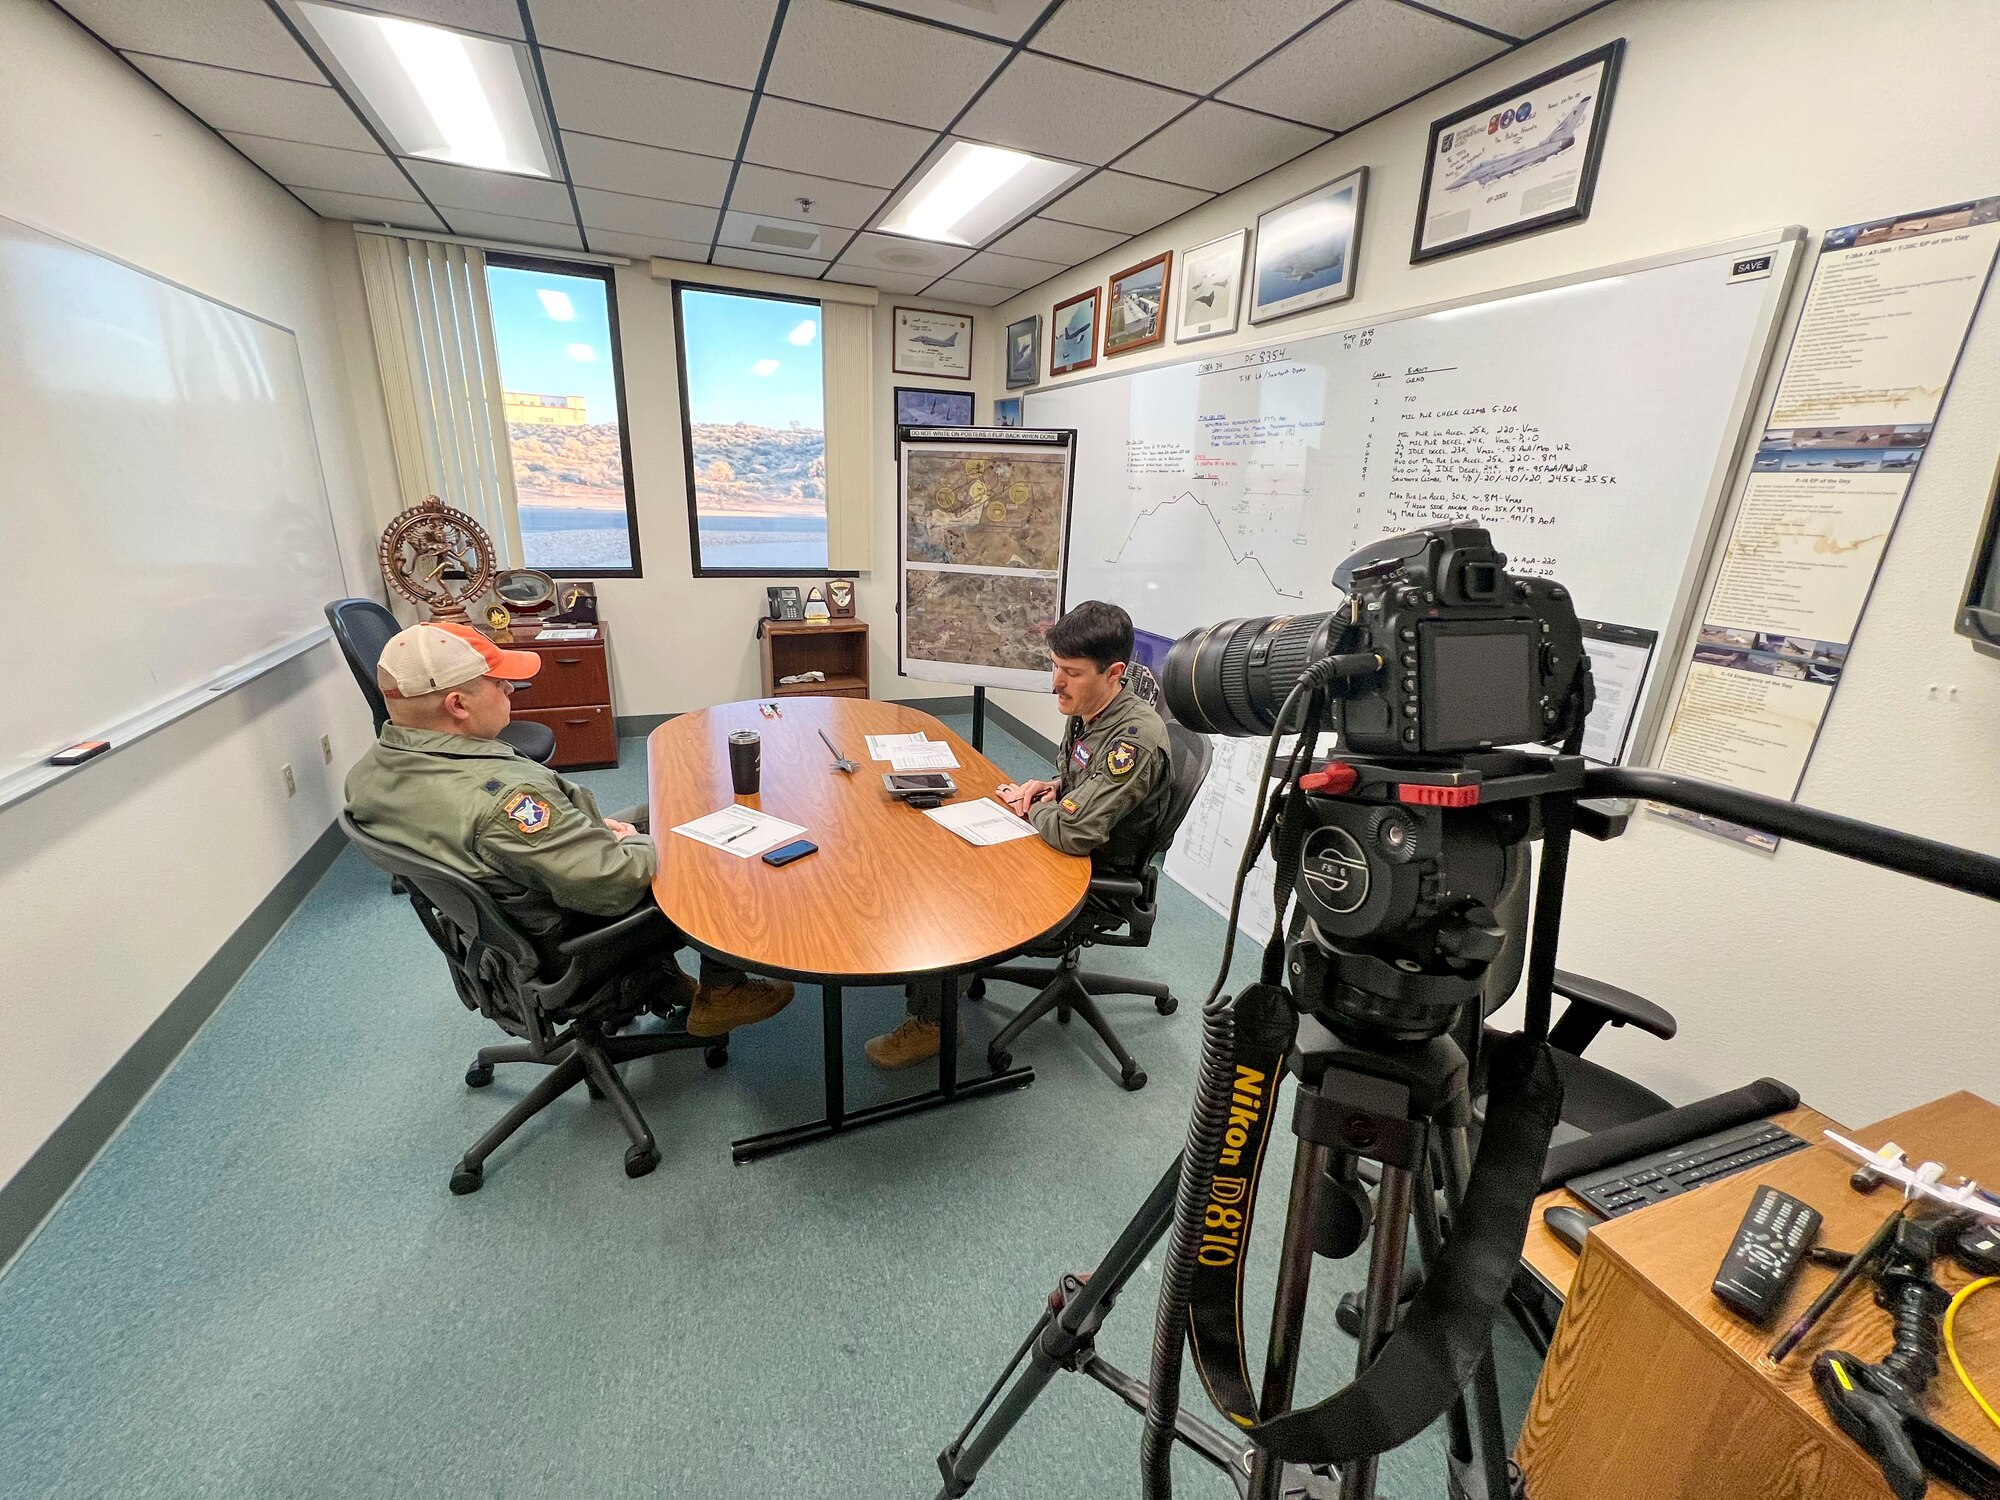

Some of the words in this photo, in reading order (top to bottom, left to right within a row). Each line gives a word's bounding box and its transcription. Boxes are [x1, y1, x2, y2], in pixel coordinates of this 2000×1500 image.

[1738, 260, 1764, 272] SAVE
[1260, 348, 1286, 362] 8354
[1556, 443, 1570, 451] WR
[1734, 673, 1764, 684] Emergency
[1340, 868, 1346, 877] 6
[1219, 1064, 1265, 1166] Nikon
[1198, 1174, 1248, 1267] D810
